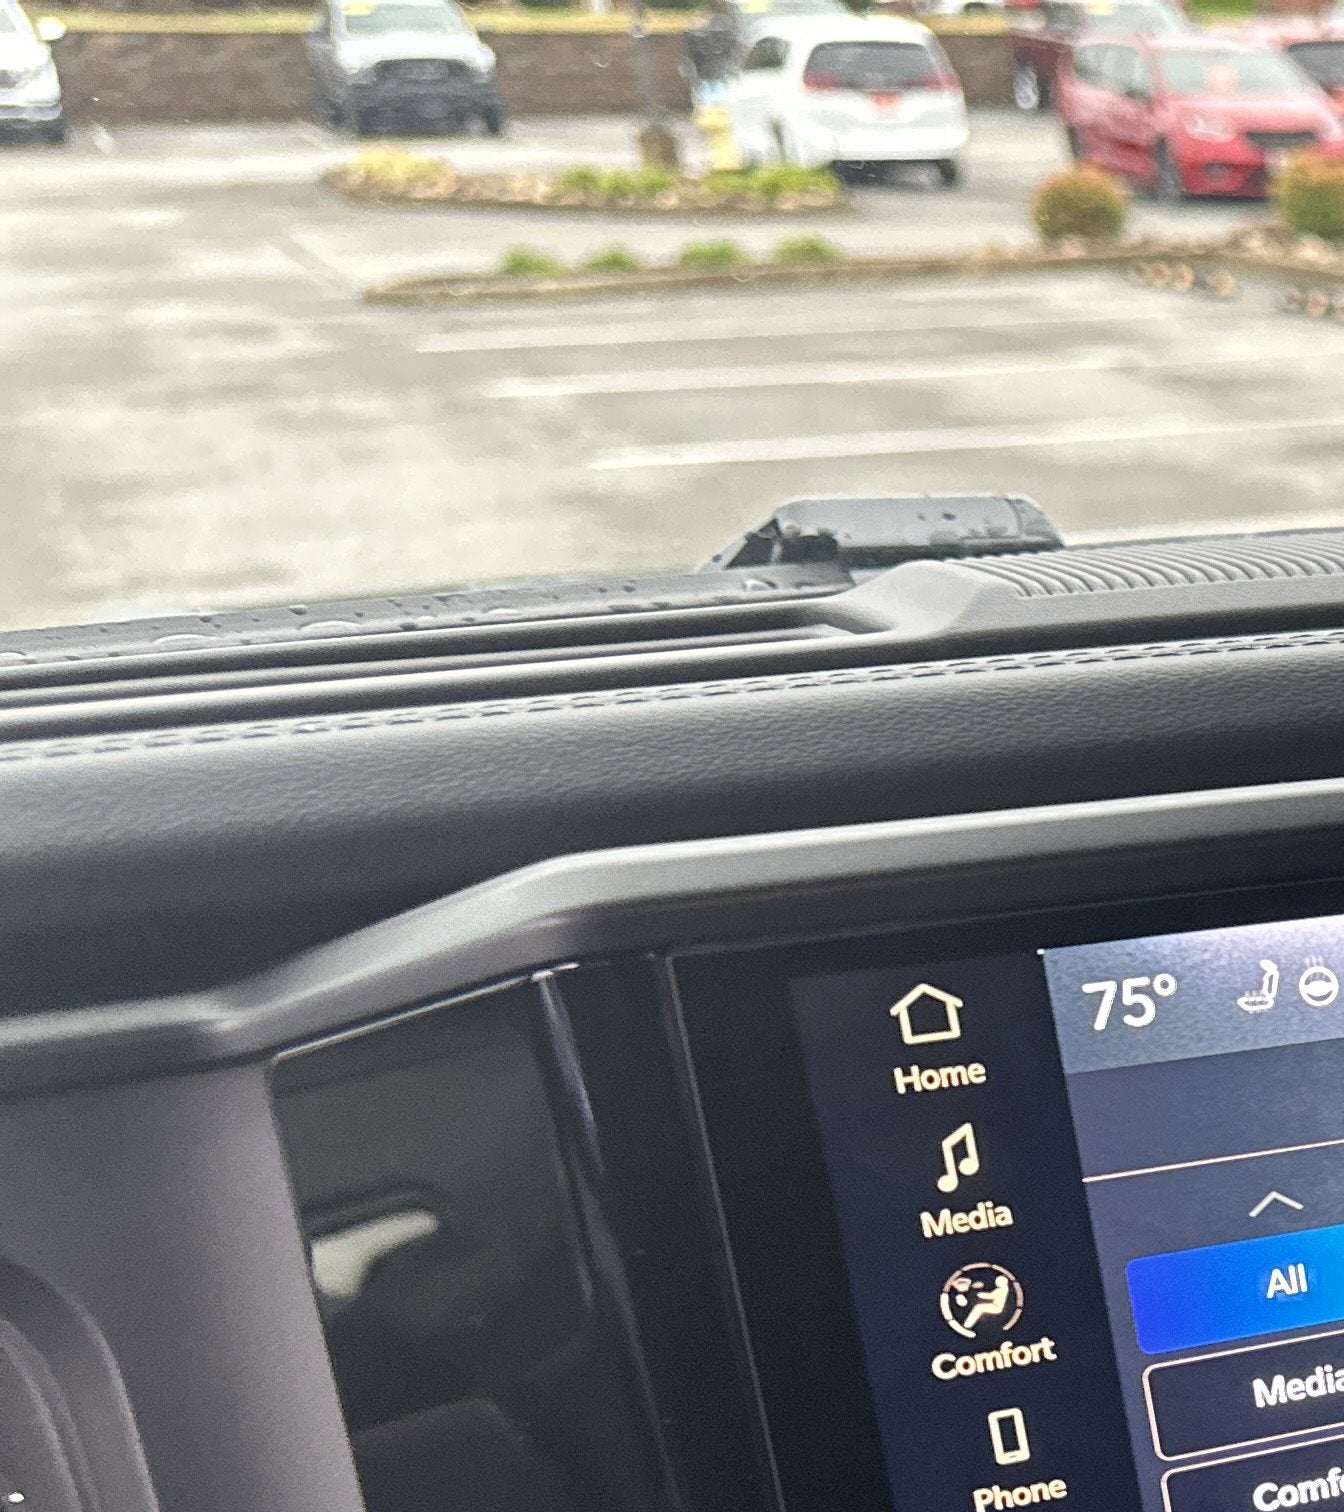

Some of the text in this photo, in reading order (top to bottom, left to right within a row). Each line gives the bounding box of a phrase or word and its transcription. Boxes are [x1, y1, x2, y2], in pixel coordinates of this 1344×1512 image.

[1082, 972, 1178, 1031] 75°
[893, 1058, 988, 1095] Home
[920, 1201, 1014, 1239] Media
[1266, 1263, 1310, 1300] All
[931, 1336, 1058, 1382] Comfort
